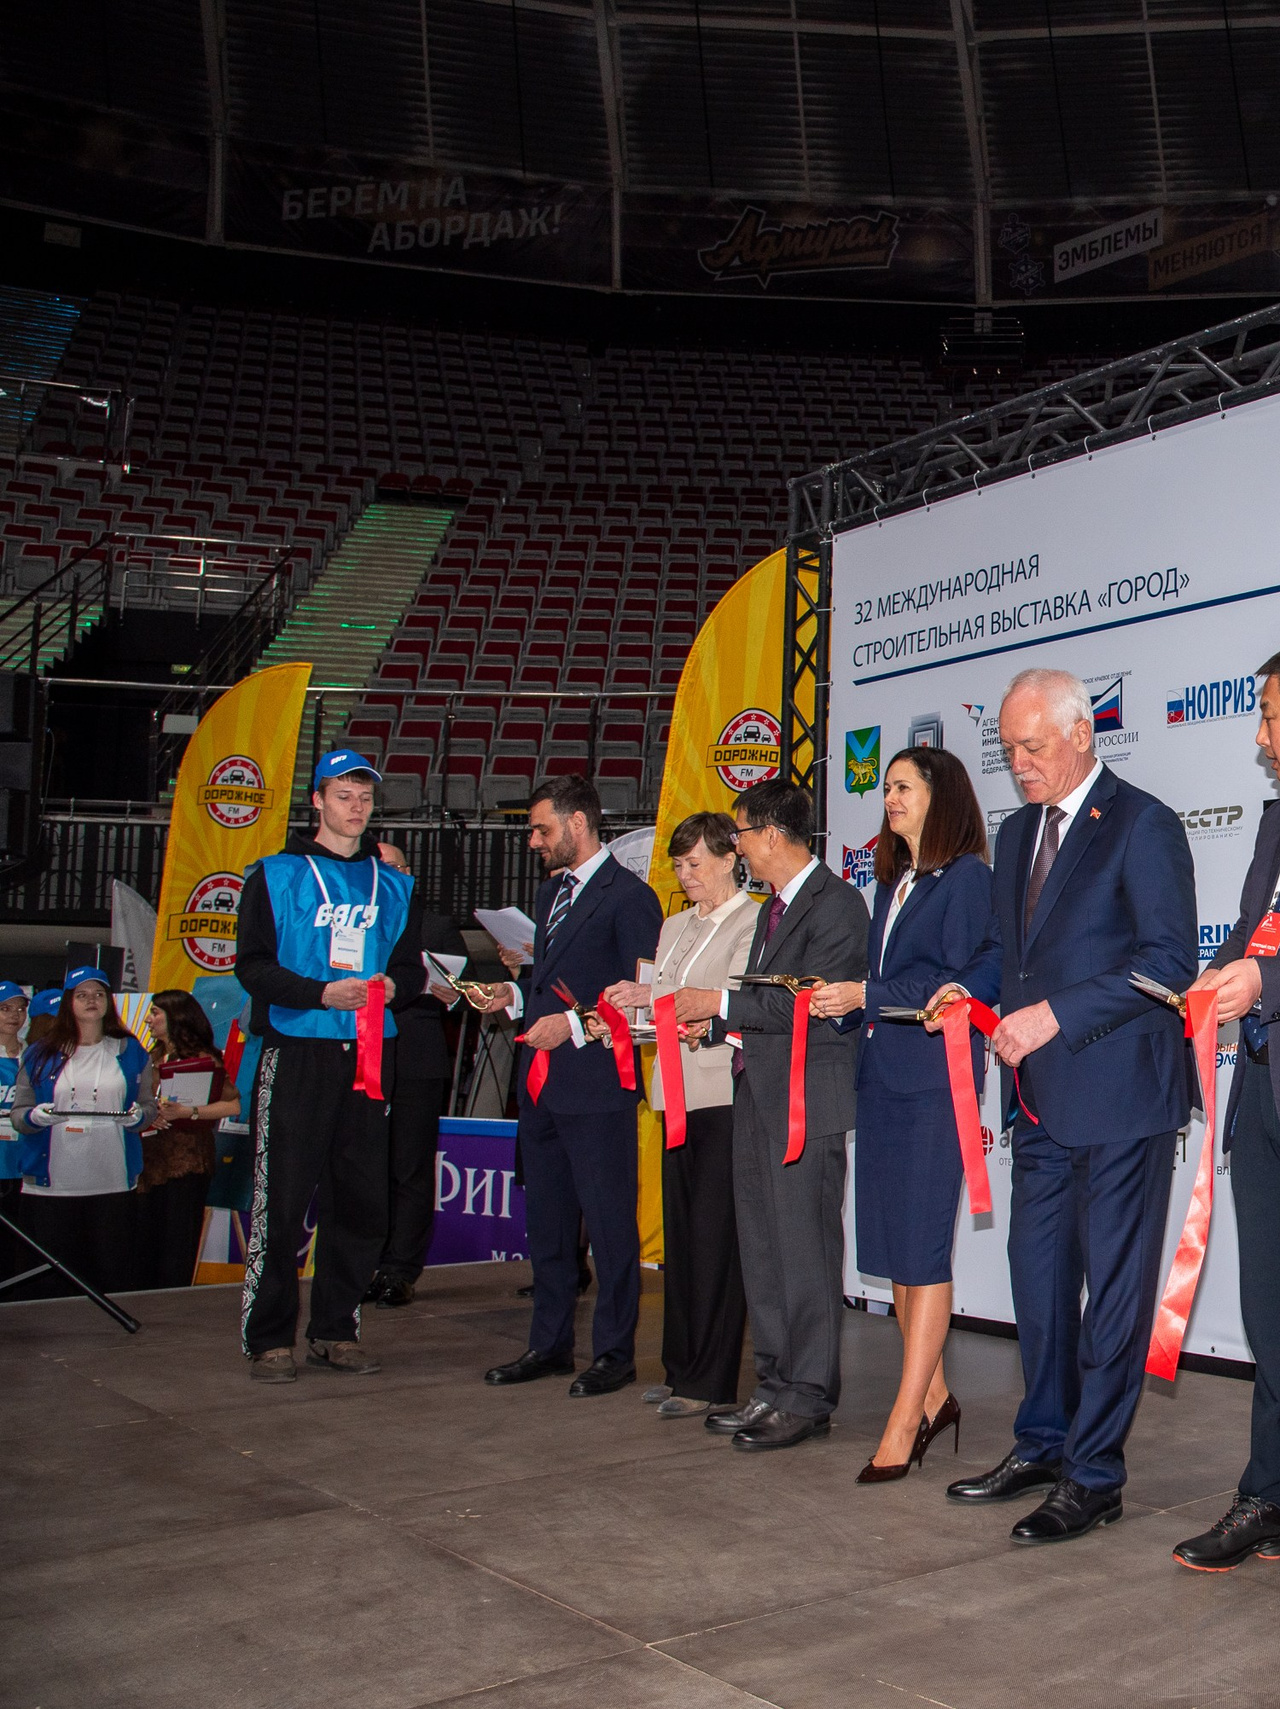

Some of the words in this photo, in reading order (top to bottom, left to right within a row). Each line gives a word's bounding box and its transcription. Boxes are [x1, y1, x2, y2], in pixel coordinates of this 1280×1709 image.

[282, 176, 410, 221] БЕРЁМ
[419, 176, 468, 211] НА
[366, 204, 562, 253] АБОРДАЖ!
[1058, 217, 1159, 272] ЭМБЛЕМЫ
[1153, 224, 1263, 280] МЕНЯЮТСЯ
[854, 600, 873, 625] 32
[877, 553, 1040, 619] МЕЖДУНАРОДНАЯ
[853, 615, 984, 667] СТРОИТЕЛЬНАЯ
[990, 589, 1092, 634] ВЫСТАВКА
[1097, 567, 1190, 609] «ГОРОД»
[1185, 676, 1256, 721] НОПРИЗ
[1098, 731, 1139, 749] РОССИИ
[740, 768, 753, 777] FM
[216, 810, 254, 825] РАДИО
[228, 806, 240, 815] FM
[314, 903, 380, 929] ВВГУ
[211, 942, 226, 953] FM
